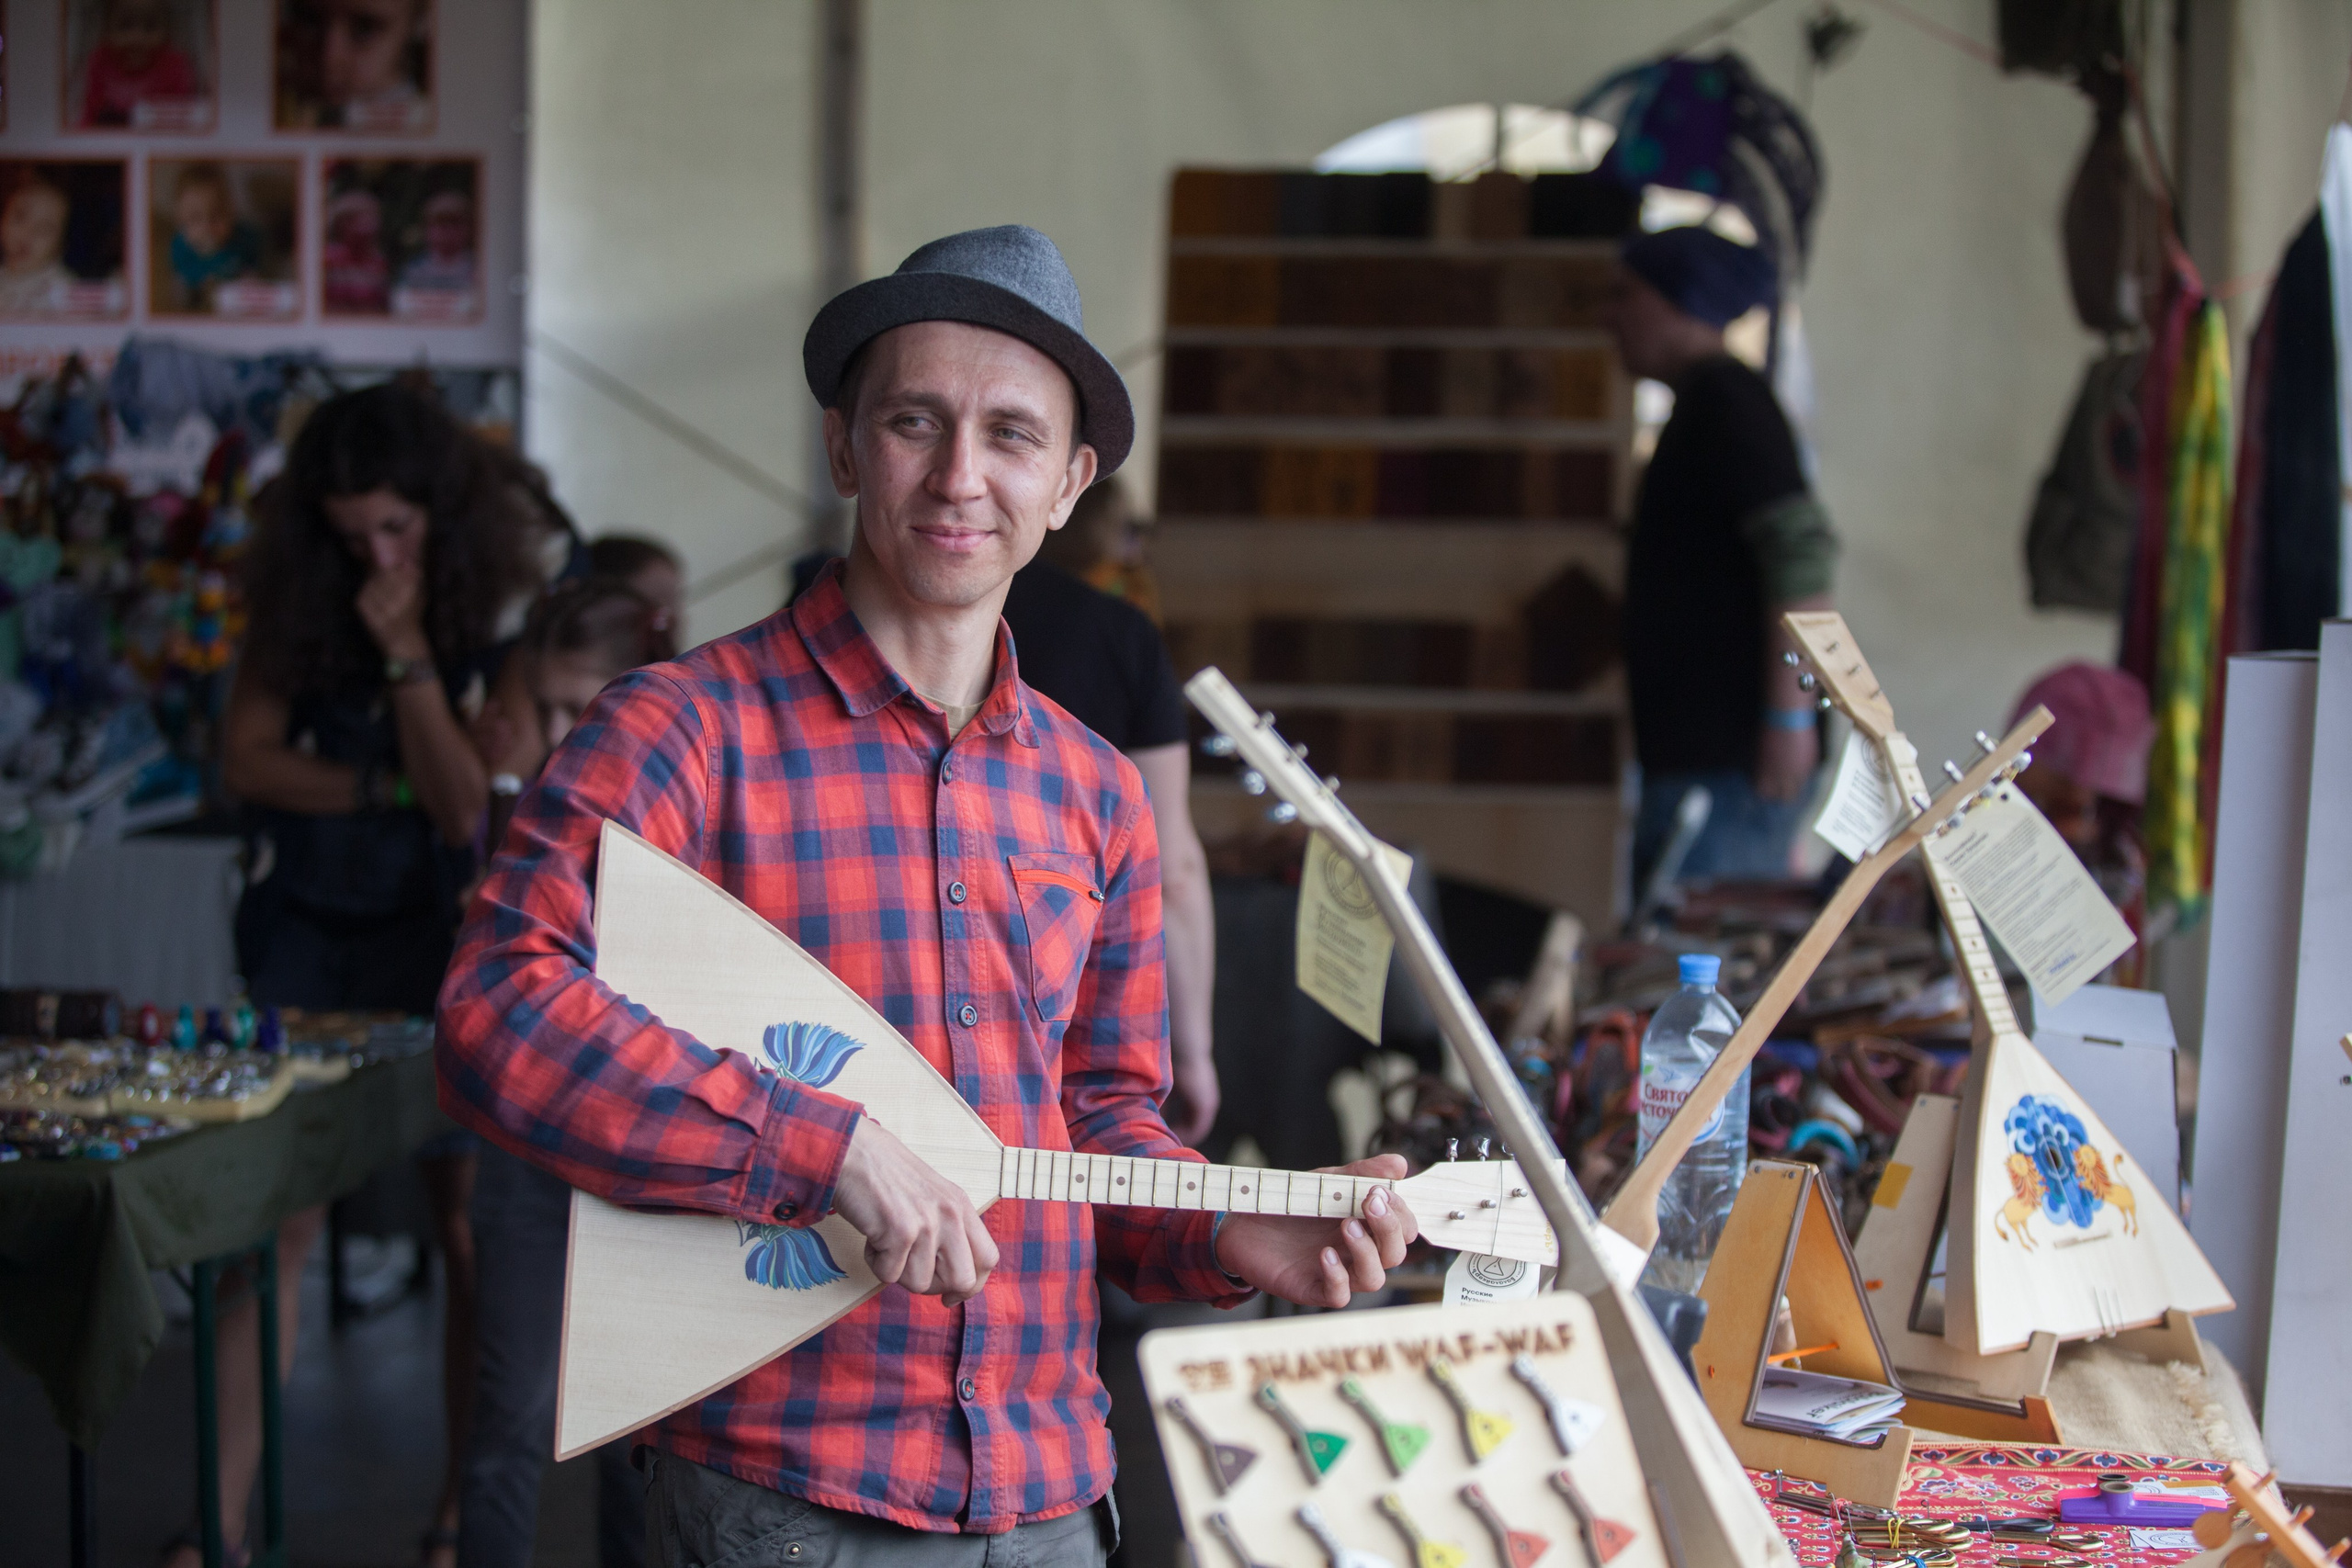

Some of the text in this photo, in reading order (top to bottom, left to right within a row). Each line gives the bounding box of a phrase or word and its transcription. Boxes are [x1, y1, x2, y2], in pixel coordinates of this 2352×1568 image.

[1645, 1082, 1689, 1103] Свято
[1462, 1287, 1493, 1297] Русские
[1395, 1322, 1573, 1369] WAF-WAF
